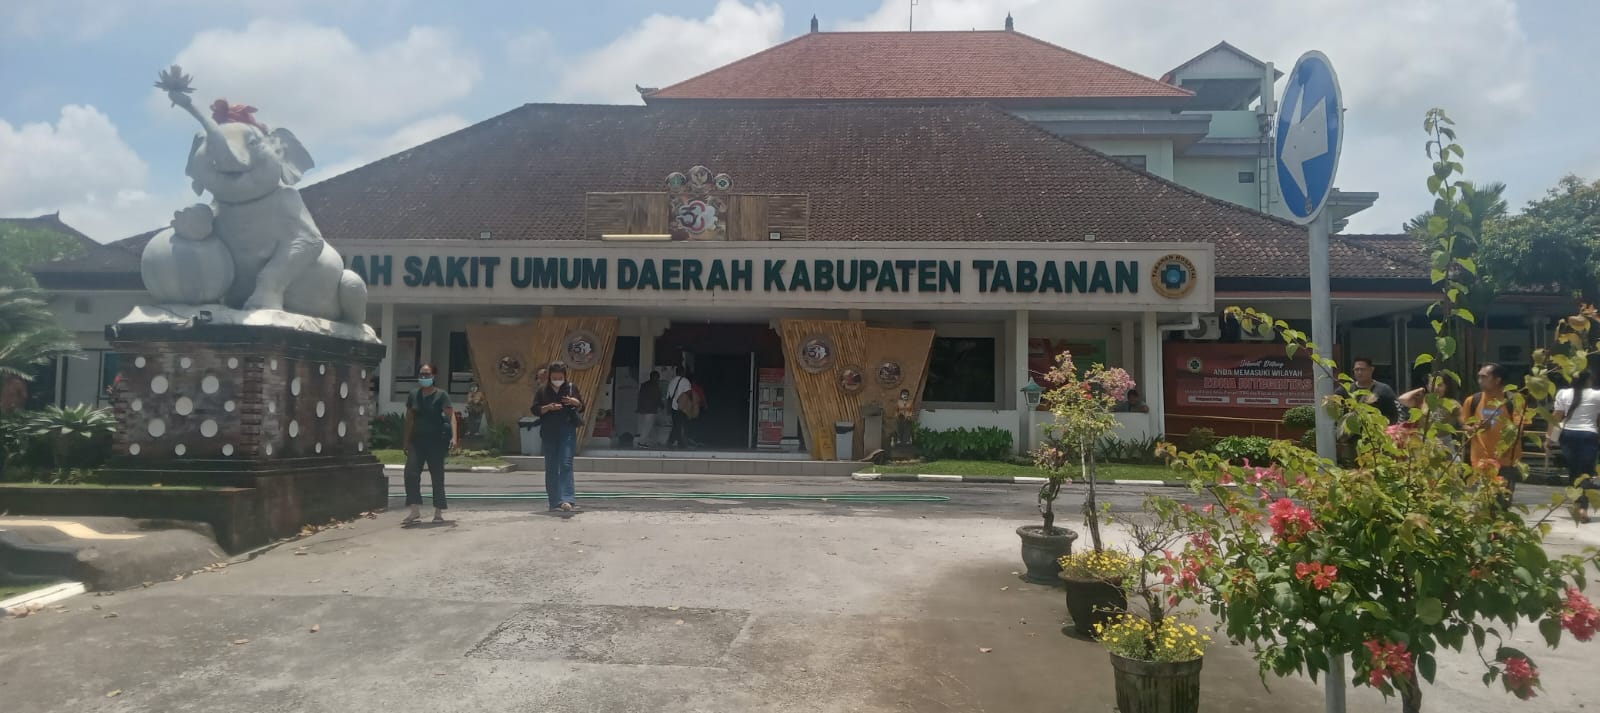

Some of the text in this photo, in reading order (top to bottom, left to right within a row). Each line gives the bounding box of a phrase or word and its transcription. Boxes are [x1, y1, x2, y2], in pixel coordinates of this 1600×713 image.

[343, 255, 1140, 294] AH SAKIT UMUM DAERAH KABUPATEN TABANAN
[1151, 255, 1197, 279] TABANAN HOSPITAL
[1234, 369, 1271, 377] MEMASUKI
[1271, 369, 1303, 377] WILAYAH
